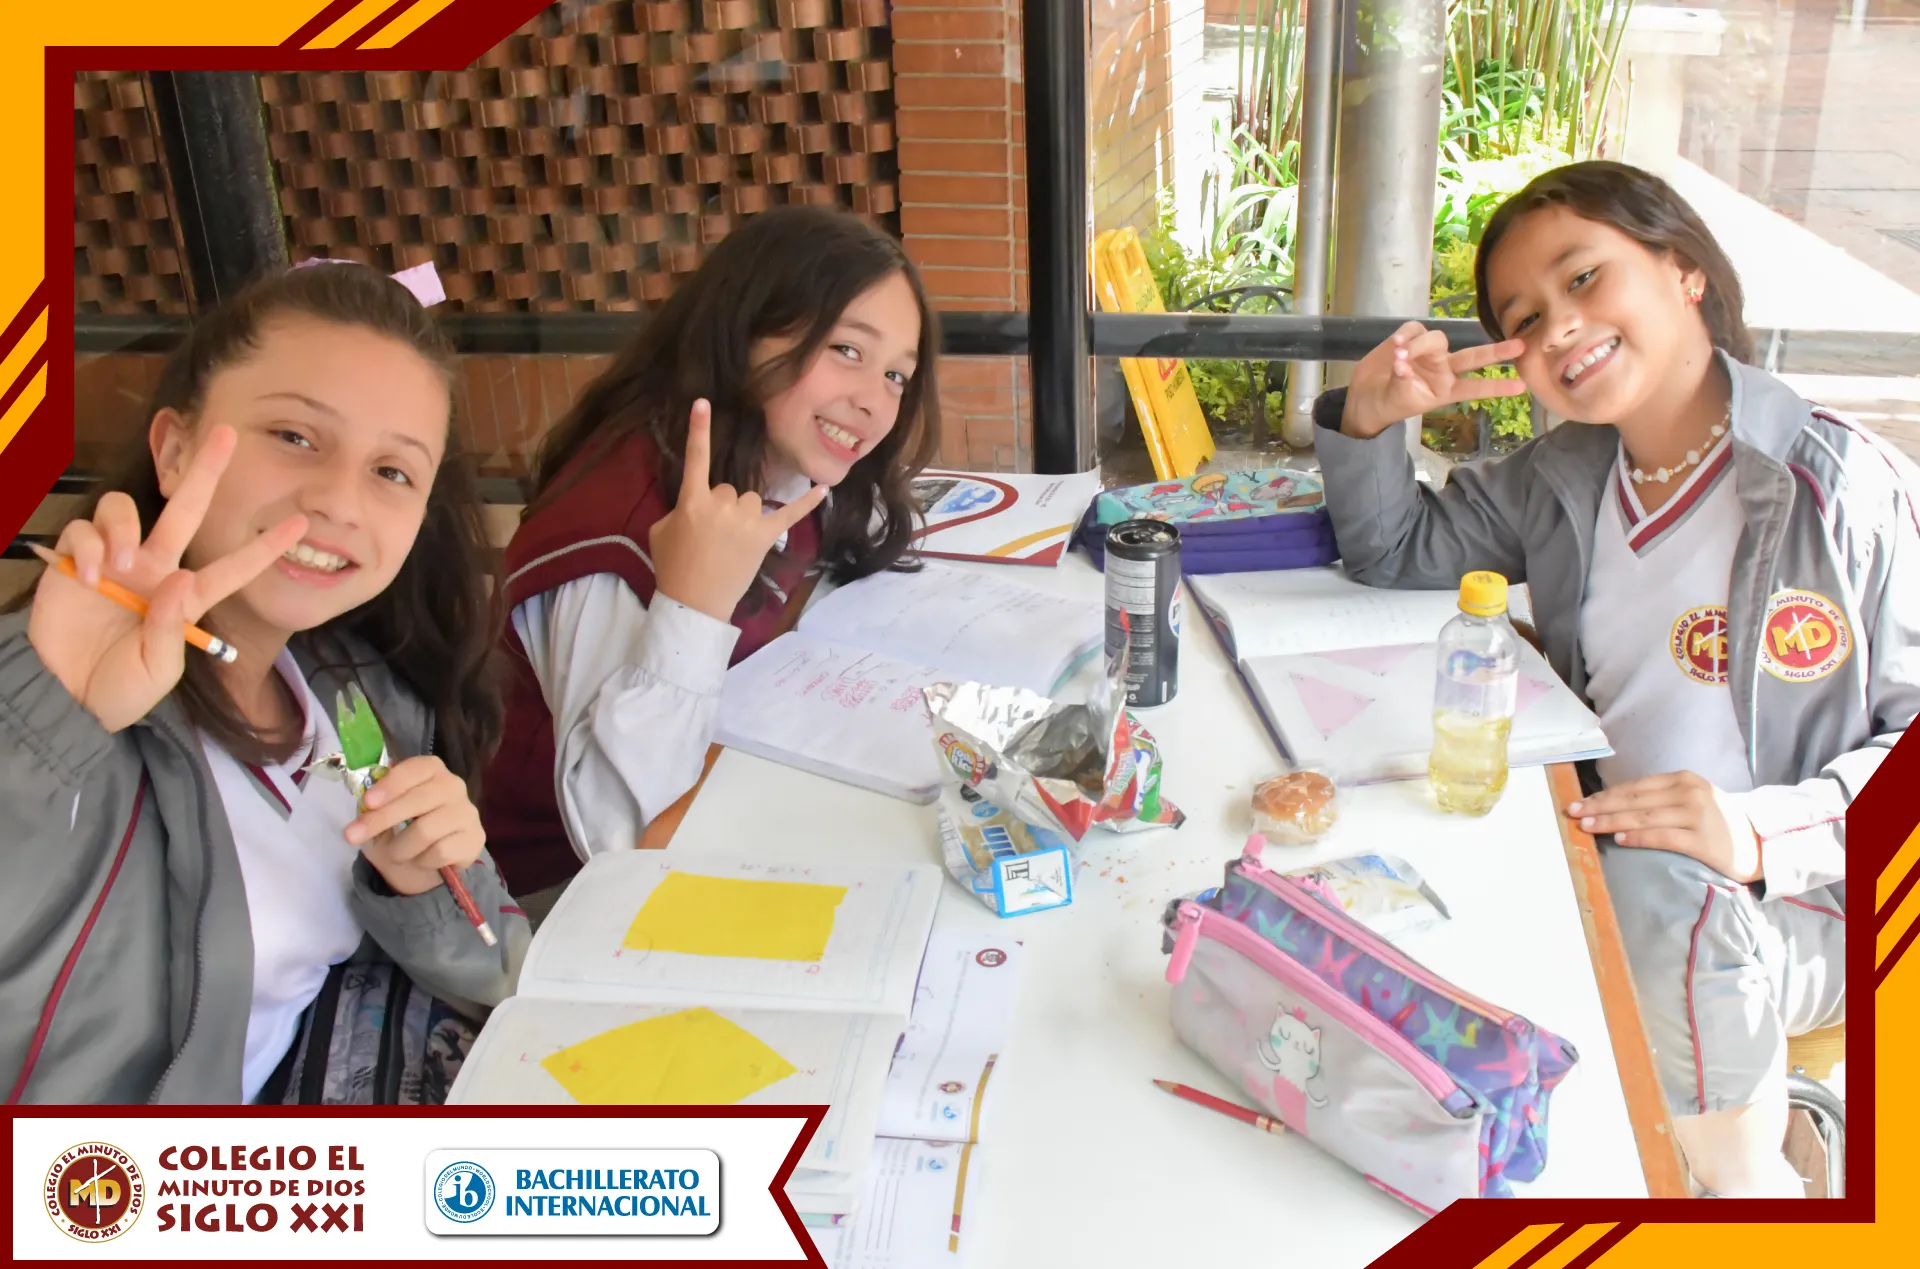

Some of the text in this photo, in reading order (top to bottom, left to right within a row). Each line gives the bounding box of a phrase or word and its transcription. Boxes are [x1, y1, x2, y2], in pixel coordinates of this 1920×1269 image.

[1776, 595, 1824, 608] MINUTO
[1771, 620, 1832, 657] MD
[1784, 659, 1838, 678] SIGLO XXI
